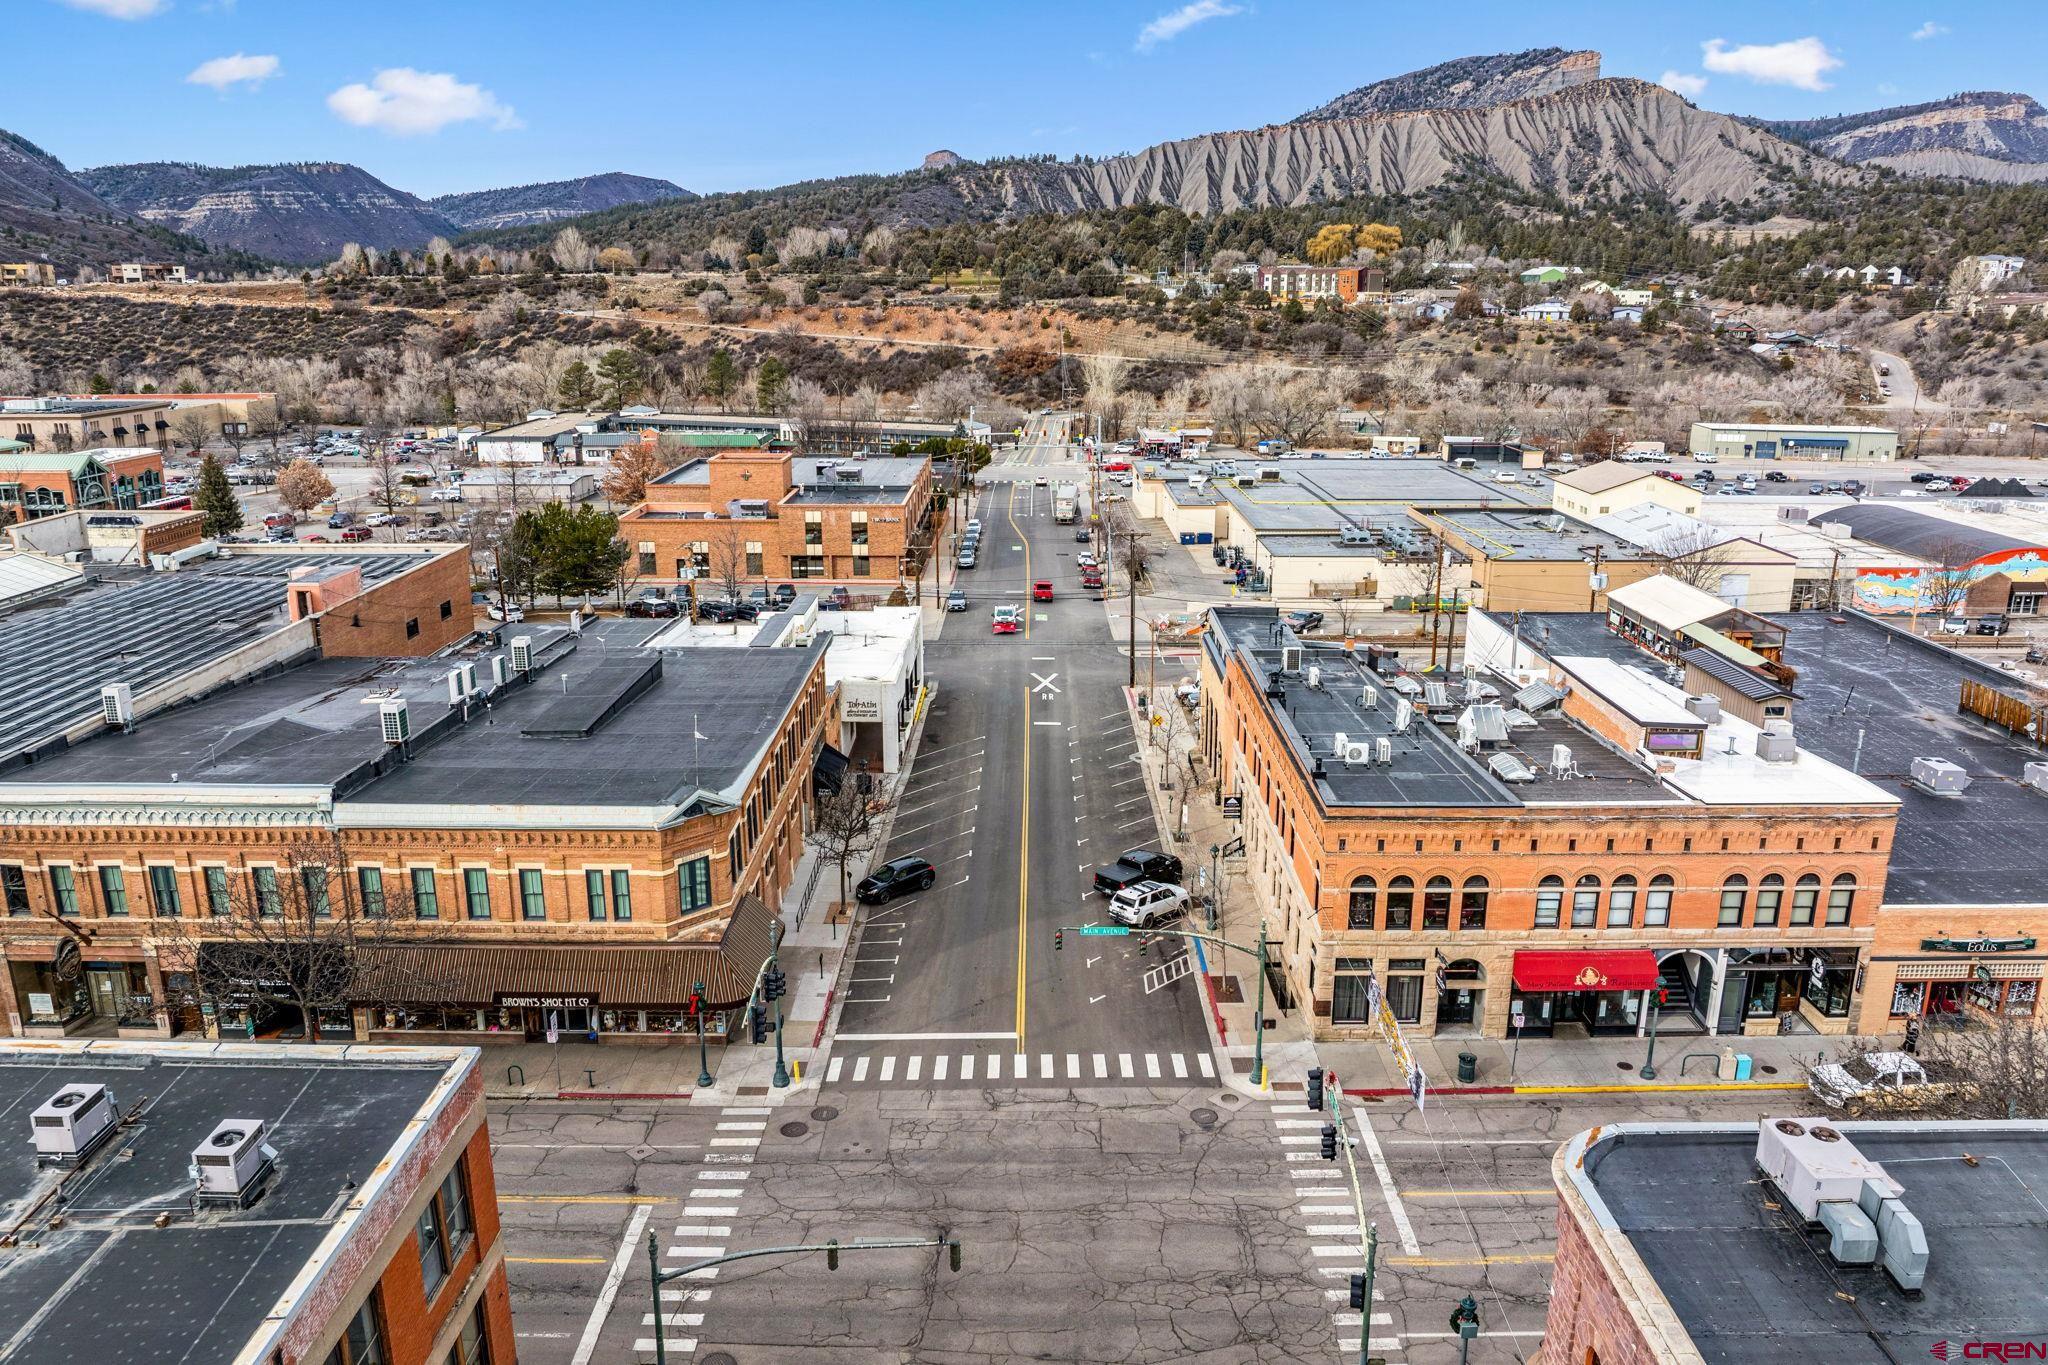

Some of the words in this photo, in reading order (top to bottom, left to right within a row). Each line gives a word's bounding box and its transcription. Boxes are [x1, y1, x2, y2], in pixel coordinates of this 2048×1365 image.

[1083, 927, 1097, 935] MAIN
[1103, 927, 1126, 935] AVENUE
[502, 997, 540, 1007] BROWN'S
[541, 997, 563, 1007] SHOE
